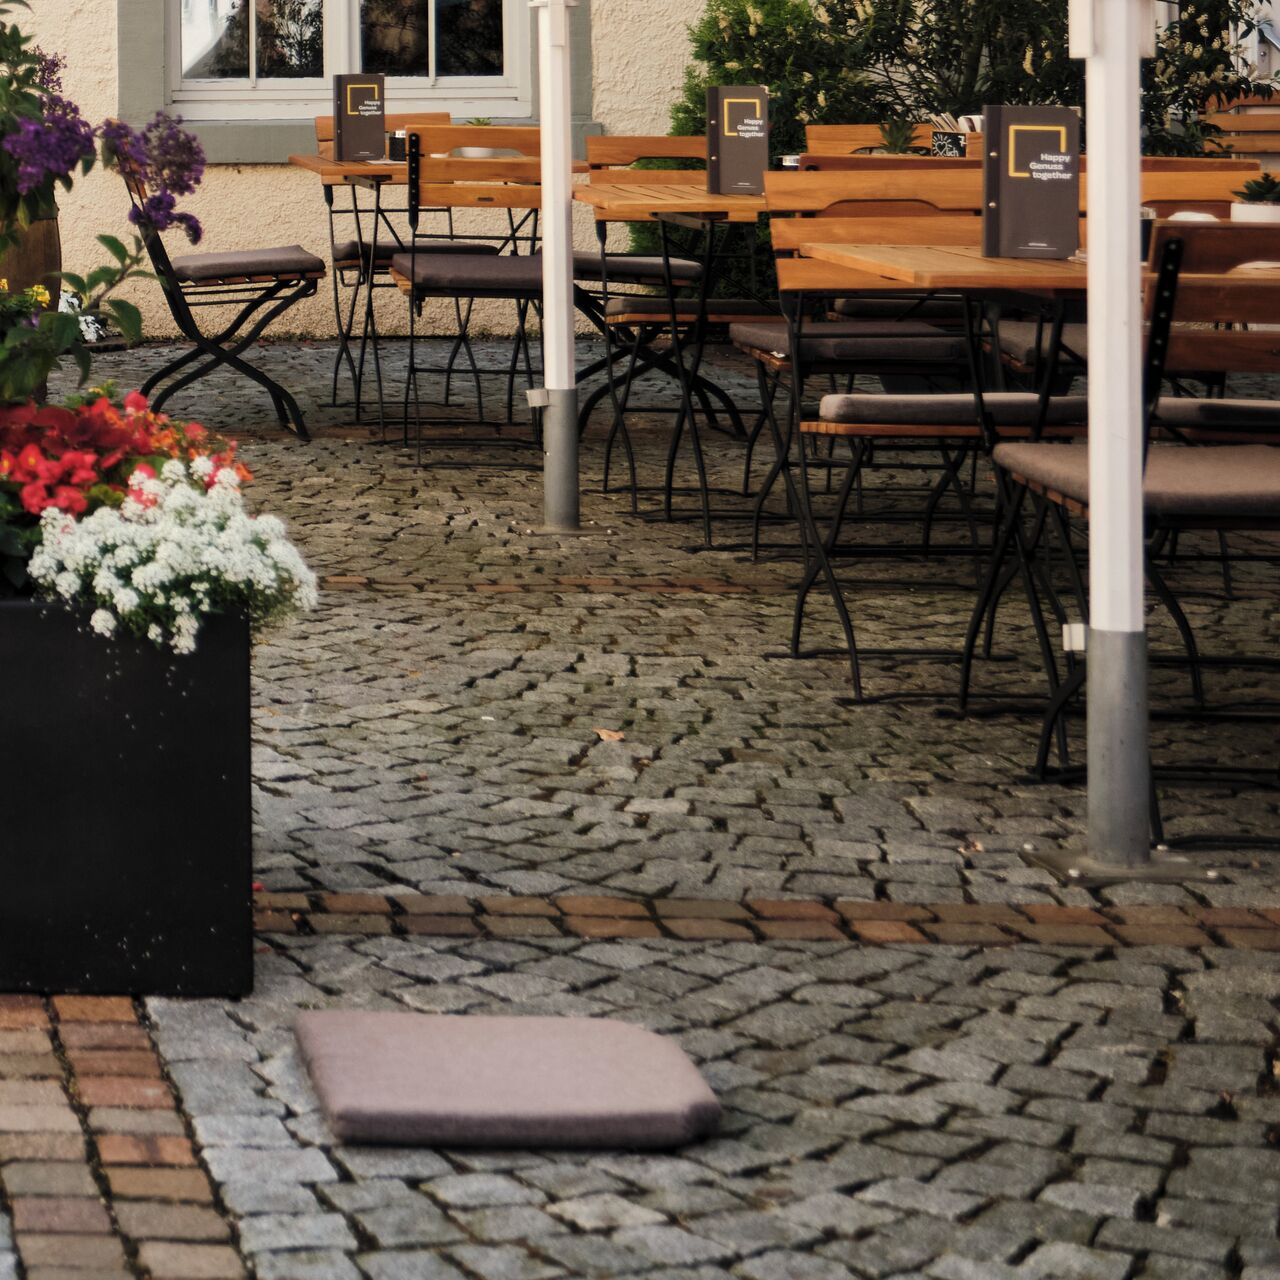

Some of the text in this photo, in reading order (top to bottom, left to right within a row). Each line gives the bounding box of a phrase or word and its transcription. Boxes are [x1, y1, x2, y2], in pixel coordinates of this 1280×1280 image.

[1040, 153, 1071, 163] Happy
[1029, 162, 1064, 170] Genuss
[1032, 171, 1072, 180] together
